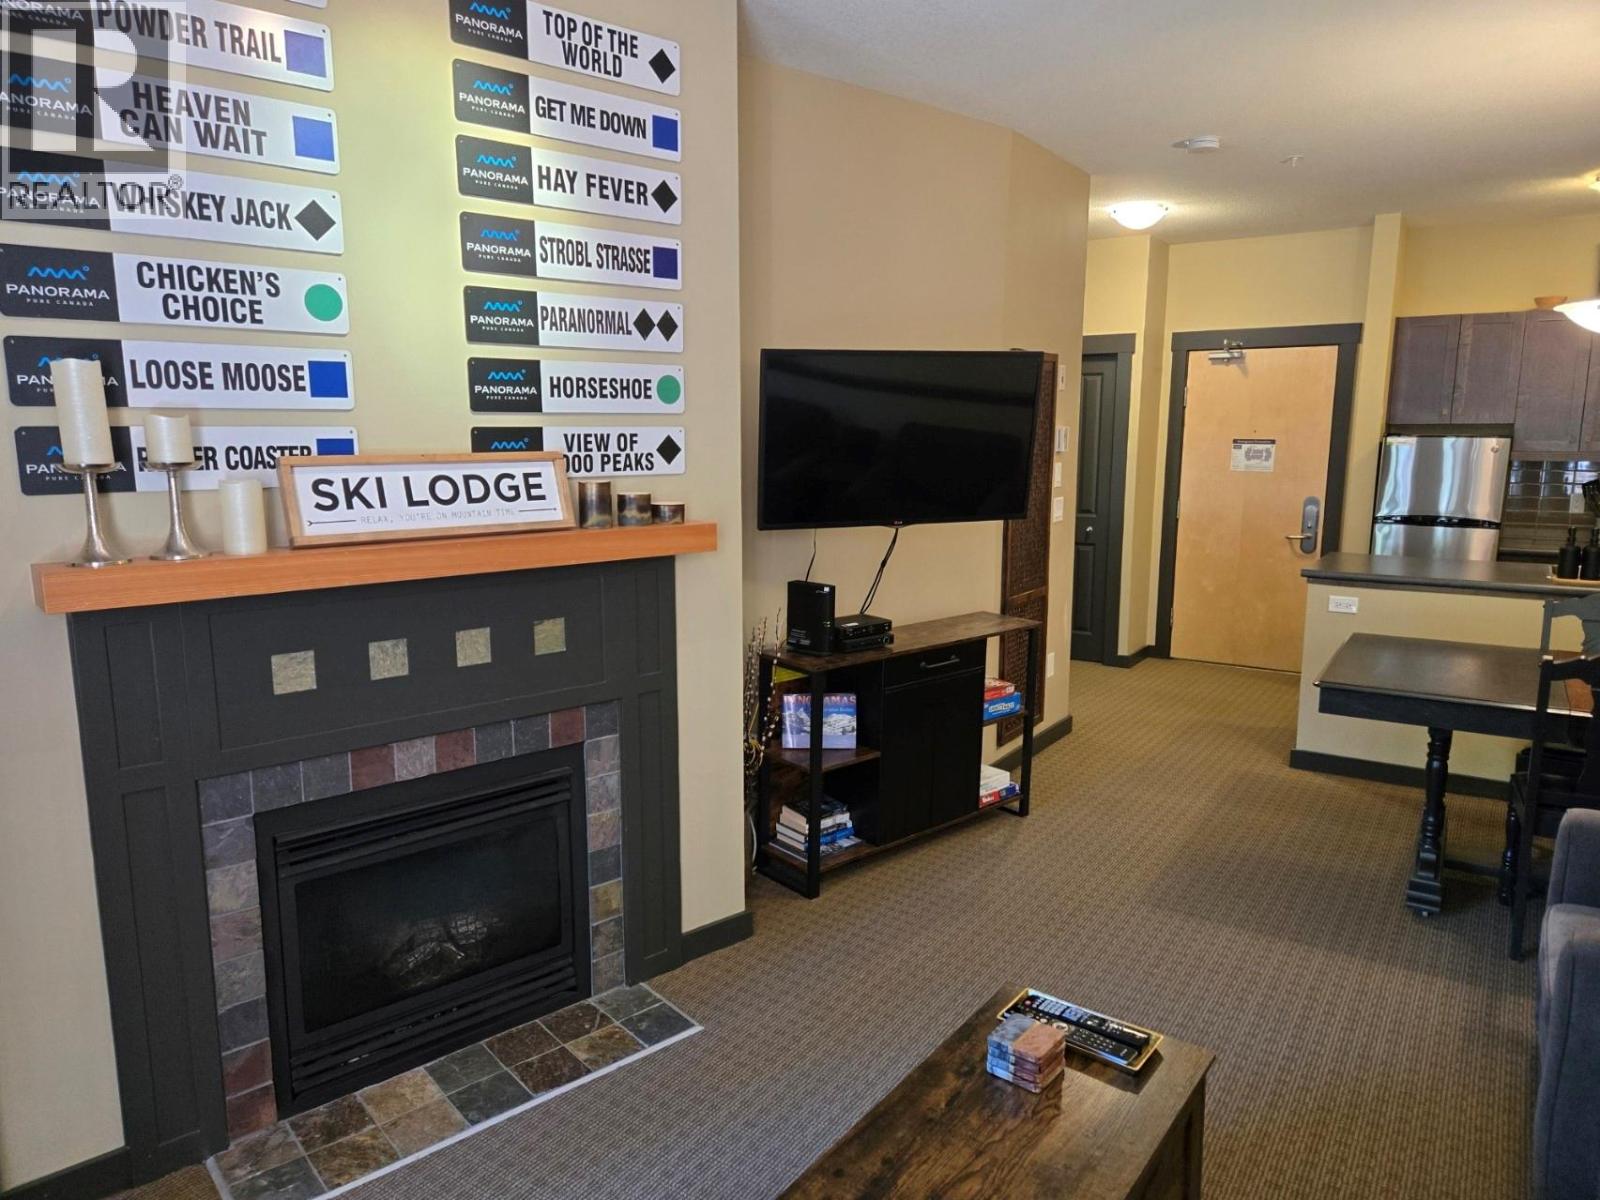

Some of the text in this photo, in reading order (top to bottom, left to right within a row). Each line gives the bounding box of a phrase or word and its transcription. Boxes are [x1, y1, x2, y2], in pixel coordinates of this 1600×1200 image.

[98, 0, 282, 64] POWDER TRAIL
[455, 13, 523, 40] PANORAMA
[543, 10, 638, 58] TOP OF THE
[561, 41, 622, 78] WORLD
[0, 91, 93, 116] ANORAMA
[132, 81, 251, 127] HEAVEN
[459, 92, 525, 114] PANORAMA
[535, 96, 647, 139] GET ME DOWN
[120, 108, 267, 156] CAN WAIT
[462, 167, 529, 186] PANORAMA
[538, 165, 649, 206] HAY FEVER
[111, 183, 293, 231] WHISKEY JACK
[466, 242, 531, 258] PANORAMA
[539, 236, 650, 274] STROBL STRASSE
[6, 283, 110, 300] PANORAMA
[136, 261, 281, 298] CHICKEN'S
[162, 294, 264, 324] CHOICE
[469, 314, 534, 327] PANORAMA
[541, 306, 632, 336] PARANORMAL
[130, 359, 306, 392] LOOSE MOOSE
[474, 385, 537, 395] PANORAMA
[550, 376, 652, 399] HORSESHOE
[563, 433, 638, 452] VIEW OF
[600, 452, 654, 472] PEAKS
[311, 472, 546, 512] SKI LODGE
